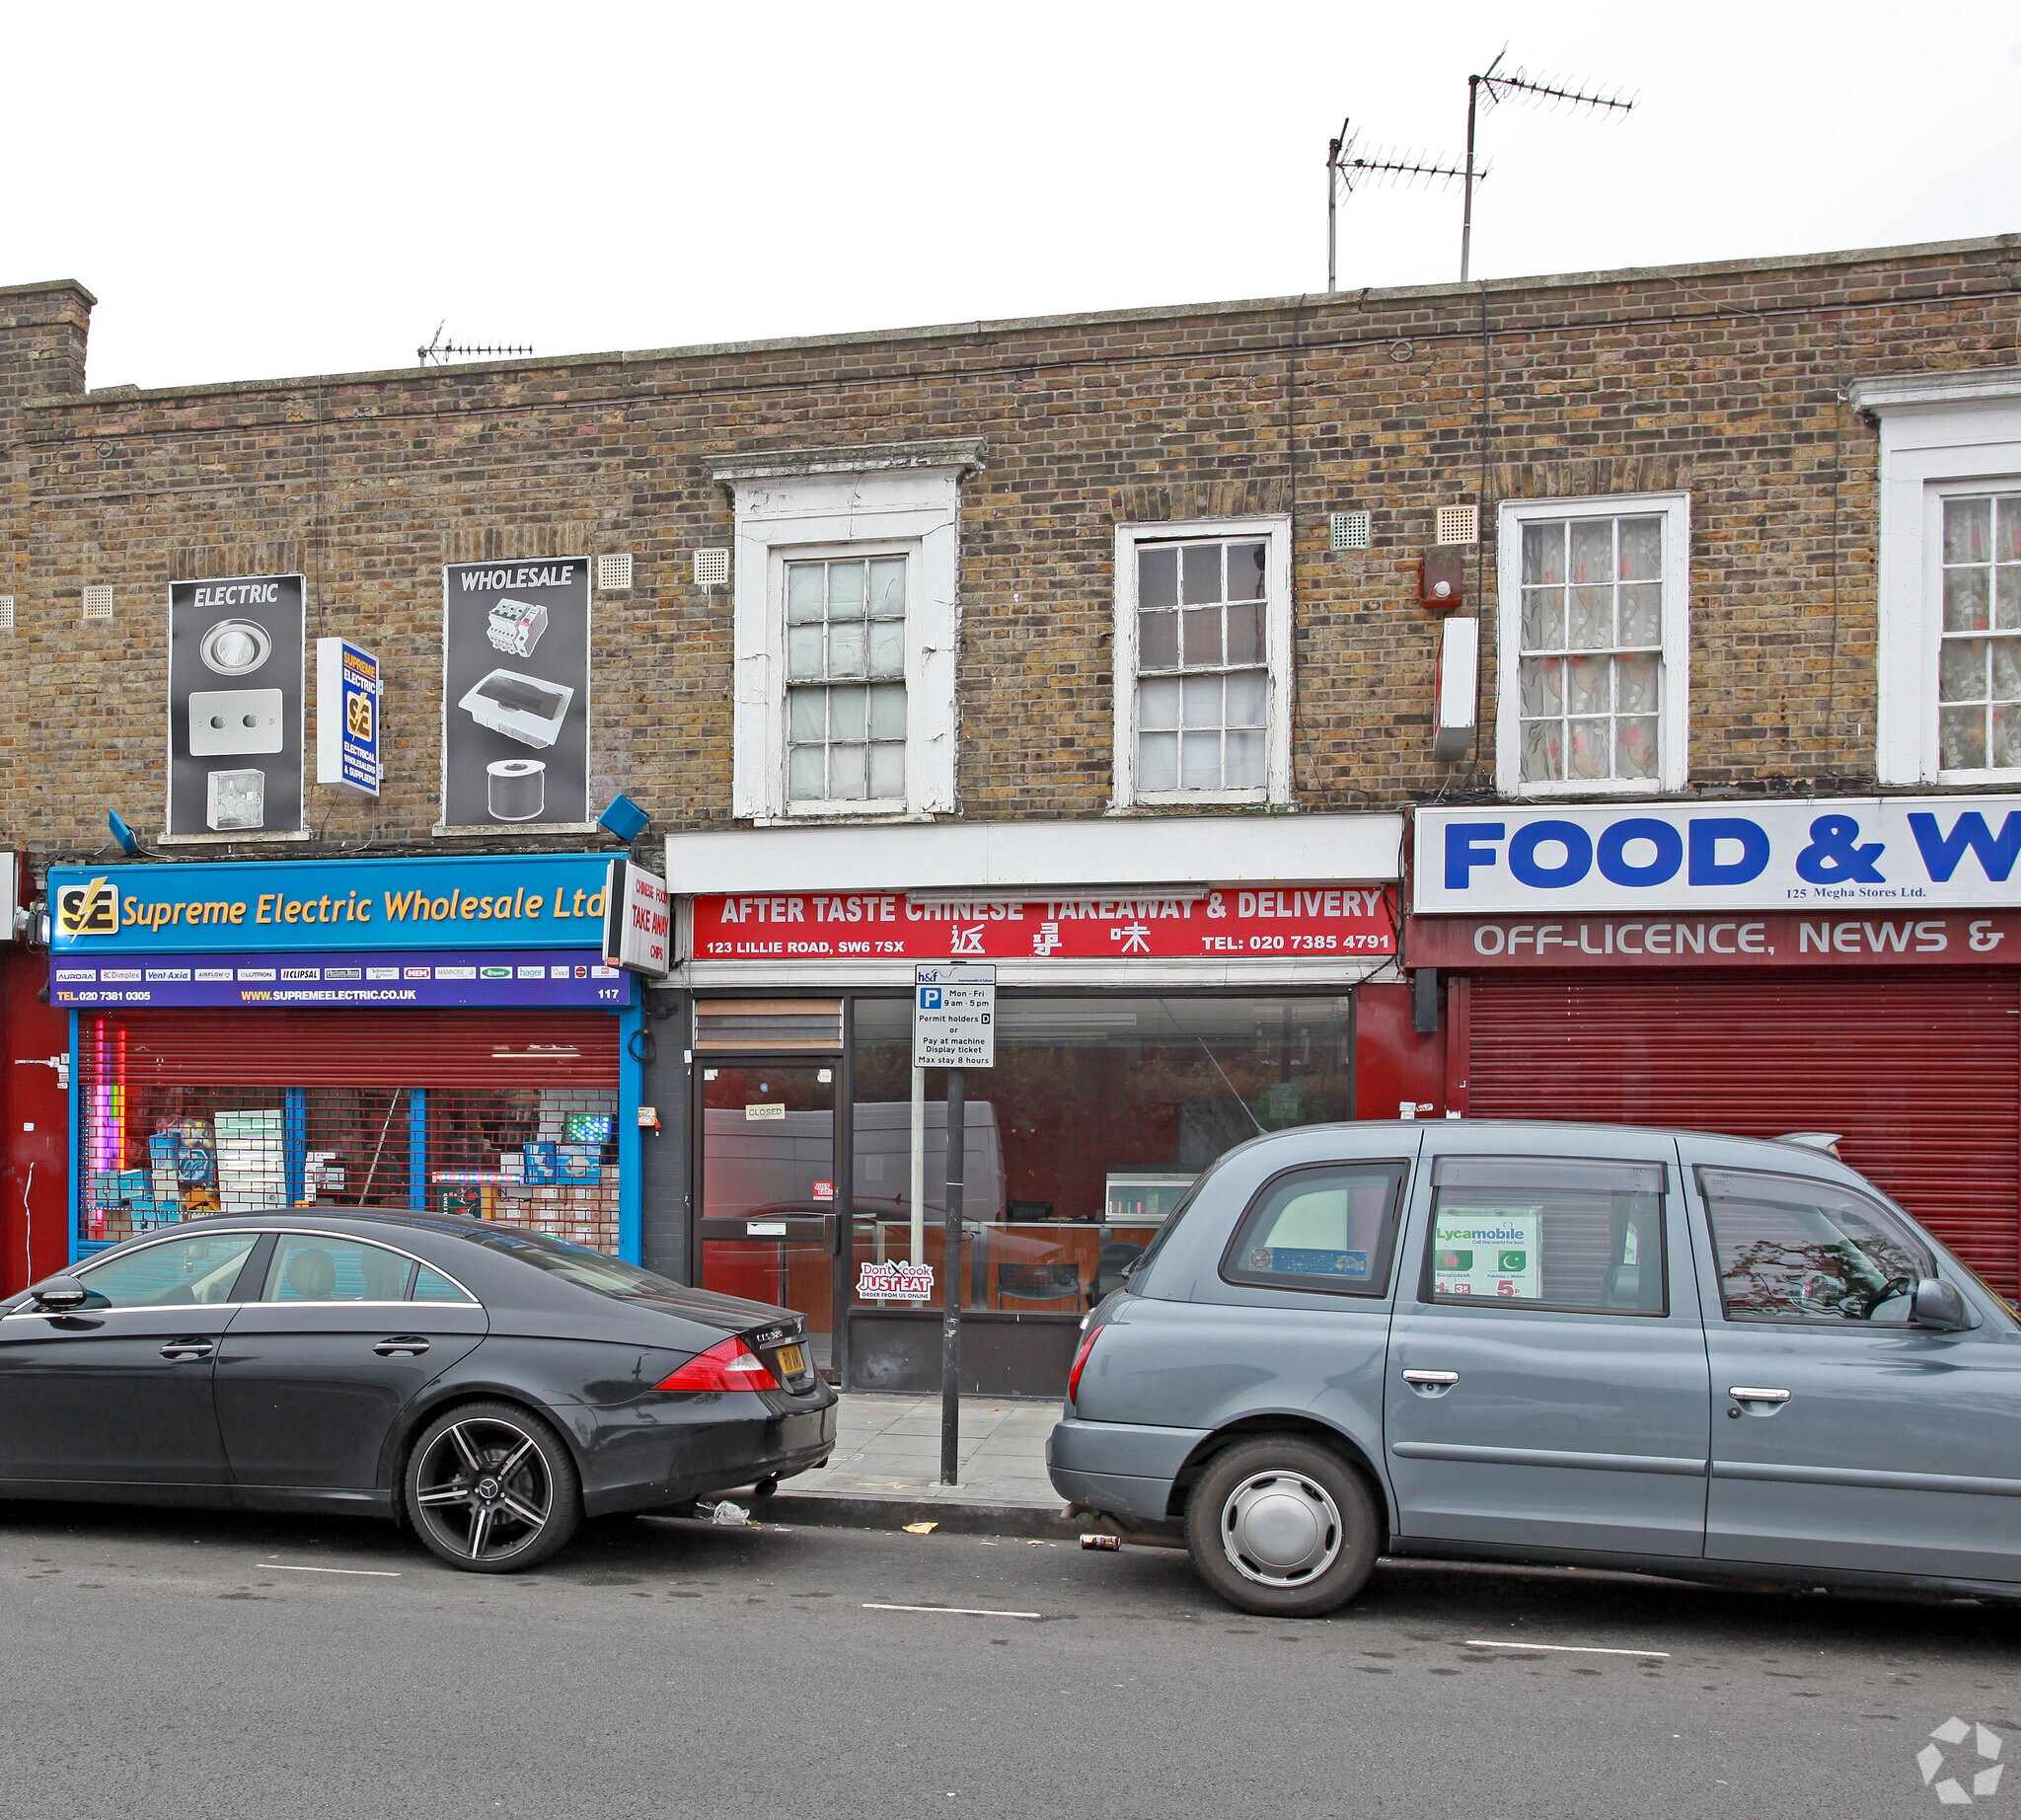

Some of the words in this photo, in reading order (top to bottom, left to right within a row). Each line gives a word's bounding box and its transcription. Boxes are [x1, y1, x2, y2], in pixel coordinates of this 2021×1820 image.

[461, 566, 574, 592] WHOLESALE
[193, 582, 279, 608] ELECTRIC
[343, 650, 376, 678] SUPREME
[343, 668, 376, 695] ELECTRIC
[343, 740, 376, 764] ELECTRICAL
[343, 753, 376, 775] WHOLESALERS
[343, 765, 349, 775] &
[349, 767, 376, 787] SUPPLIERS
[1444, 817, 1771, 889] FOOD
[1795, 813, 1886, 884] &
[1907, 811, 2021, 883] W
[636, 878, 654, 899] CHINESE
[1786, 888, 1807, 899] 125
[1813, 887, 1855, 899] Megha
[1858, 886, 1897, 897] Stores
[1901, 886, 1926, 897] Ltd.
[121, 896, 247, 933] Supreme
[255, 890, 372, 924] Electric
[384, 887, 544, 921] Wholesale
[553, 885, 607, 919] Ltd
[720, 897, 805, 924] AFTER
[812, 896, 896, 923] TASTE
[905, 900, 1024, 922] CHINESE
[1047, 899, 1194, 920] TAKEAWAY
[1206, 892, 1228, 919] &
[1237, 889, 1382, 918] DELIVERY
[633, 904, 650, 933] TAKE
[651, 912, 669, 939] AWAY
[1201, 937, 1243, 950] TEL:
[1249, 936, 1284, 949] 020
[1290, 935, 1337, 949] 7385
[1342, 935, 1388, 948] 4791
[1473, 923, 1774, 956] OFF-LICENCE,
[1799, 920, 1948, 953] NEWS
[1967, 920, 2005, 952] &
[650, 945, 664, 960] CHIPS
[707, 942, 733, 953] 123
[736, 942, 784, 953] LILLIE
[786, 942, 834, 955] ROAD,
[838, 942, 870, 953] SW6
[874, 941, 905, 952] 7SX
[289, 970, 318, 979] CLIPSAL
[519, 968, 543, 978] hager
[918, 971, 938, 982] h&f
[100, 991, 123, 1001] 7381
[125, 991, 151, 1001] 0305
[241, 990, 416, 1001] WWW.SUPREMEELECTRIC.CO.UK
[598, 989, 620, 999] 117
[925, 990, 939, 1008] P
[923, 1037, 937, 1046] Pay
[937, 1056, 955, 1065] stay
[748, 1107, 783, 1116] CLOSED
[1436, 1228, 1525, 1242] Lycamobile
[863, 1264, 892, 1275] Don't
[902, 1265, 931, 1276] cook
[860, 1276, 898, 1291] JUST
[900, 1277, 931, 1292] EAT
